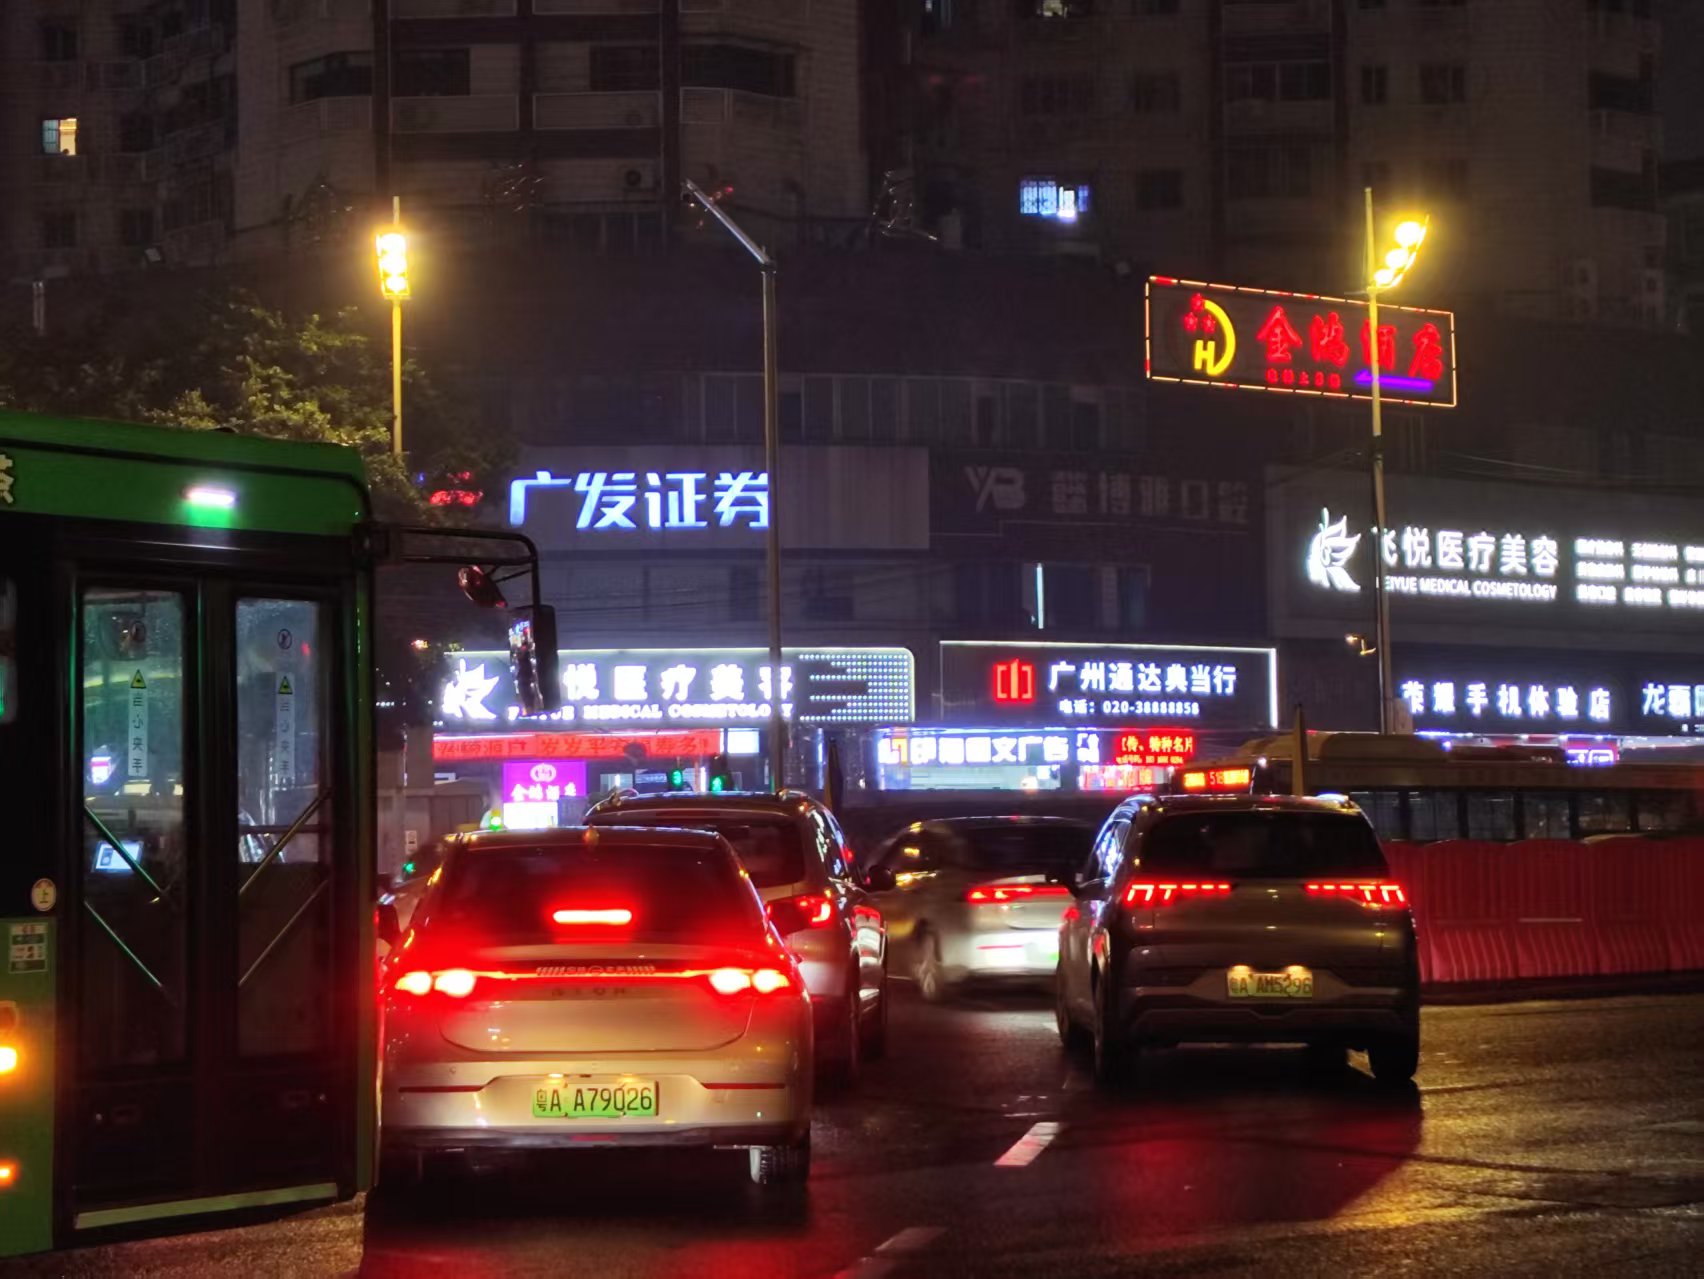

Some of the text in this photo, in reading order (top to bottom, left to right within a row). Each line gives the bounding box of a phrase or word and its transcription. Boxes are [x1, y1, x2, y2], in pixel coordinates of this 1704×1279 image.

[509, 470, 769, 529] 广发证券
[1419, 577, 1472, 597] MEDICAL
[1473, 578, 1558, 601] COSMETOLOGY
[1048, 660, 1238, 695] 广州通达典当行
[667, 702, 794, 720] COSMETOLOY
